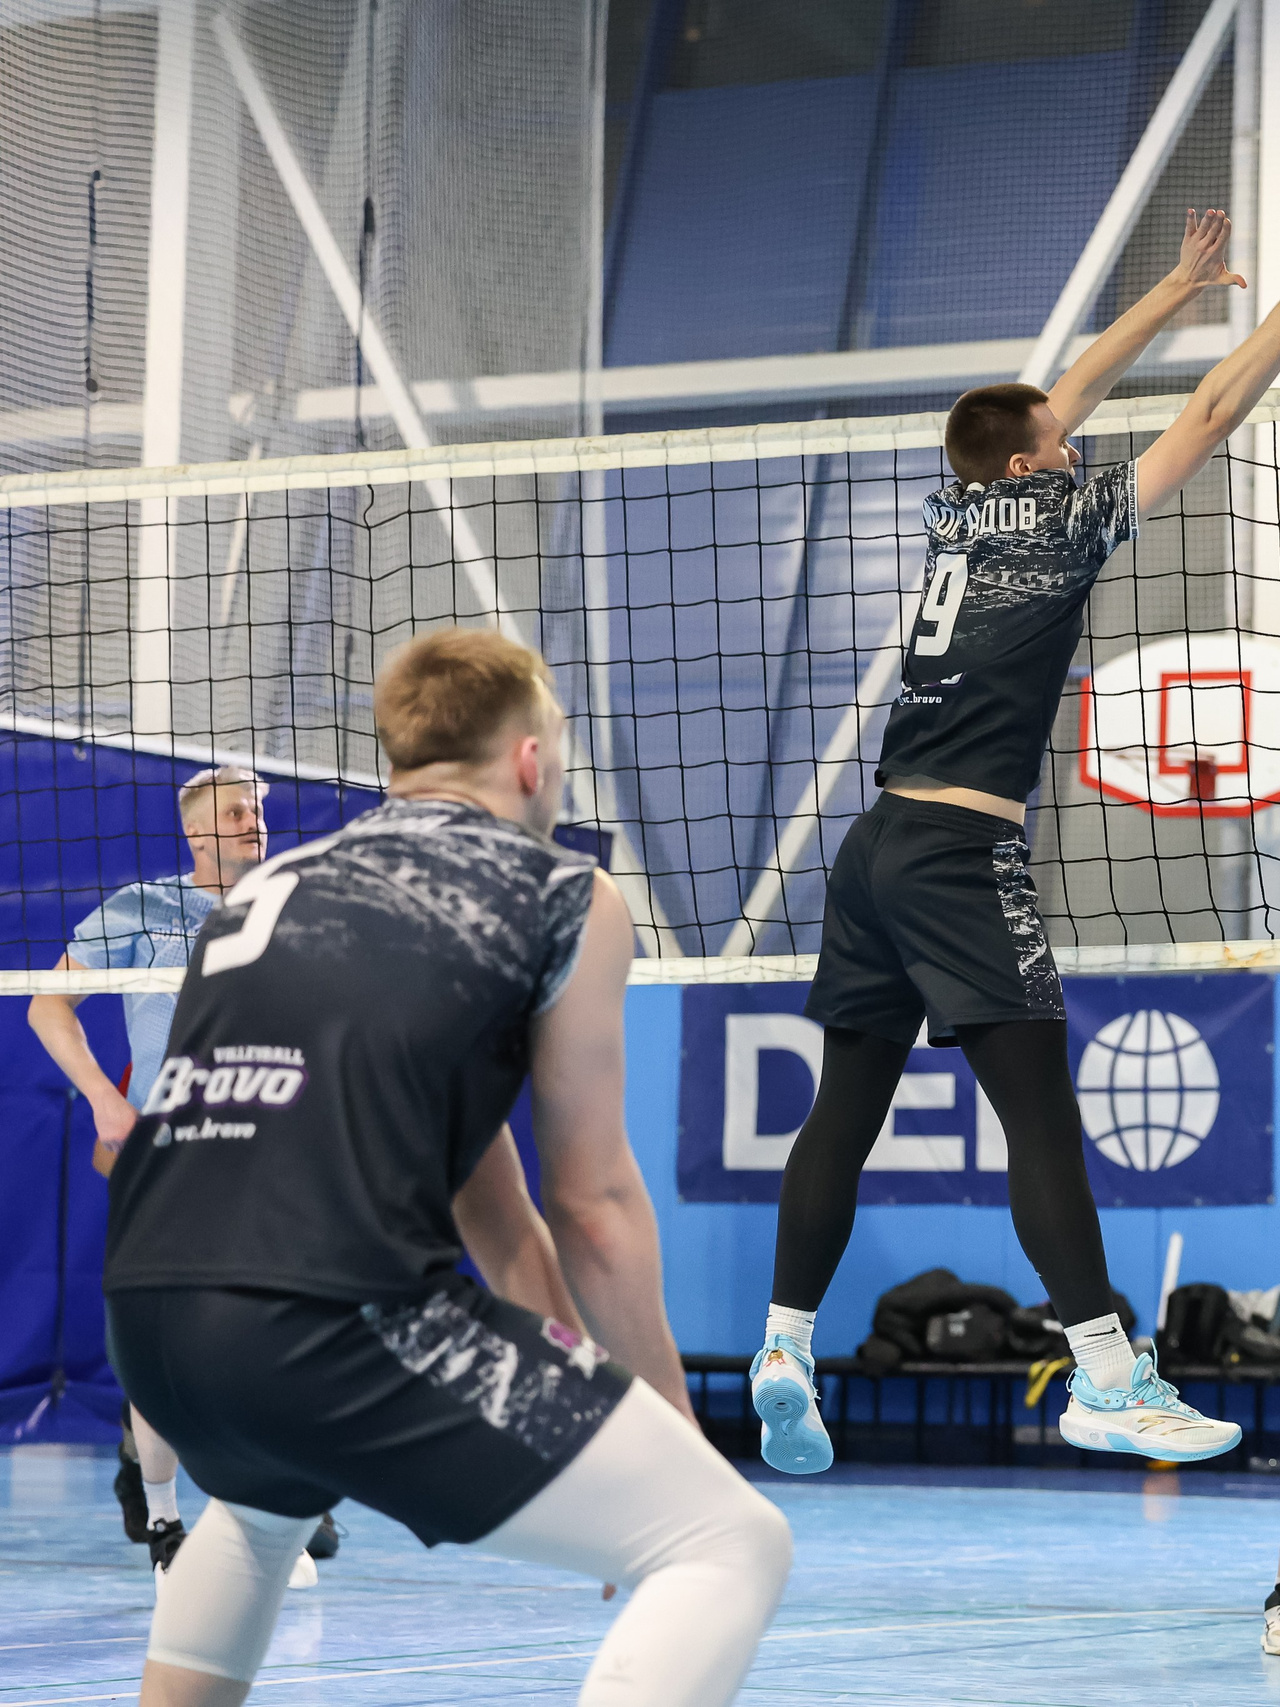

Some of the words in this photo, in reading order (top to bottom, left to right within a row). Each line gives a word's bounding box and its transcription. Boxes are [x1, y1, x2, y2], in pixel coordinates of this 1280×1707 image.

[915, 552, 968, 657] 9
[141, 1056, 304, 1116] Bravo
[723, 1012, 1009, 1172] DE
